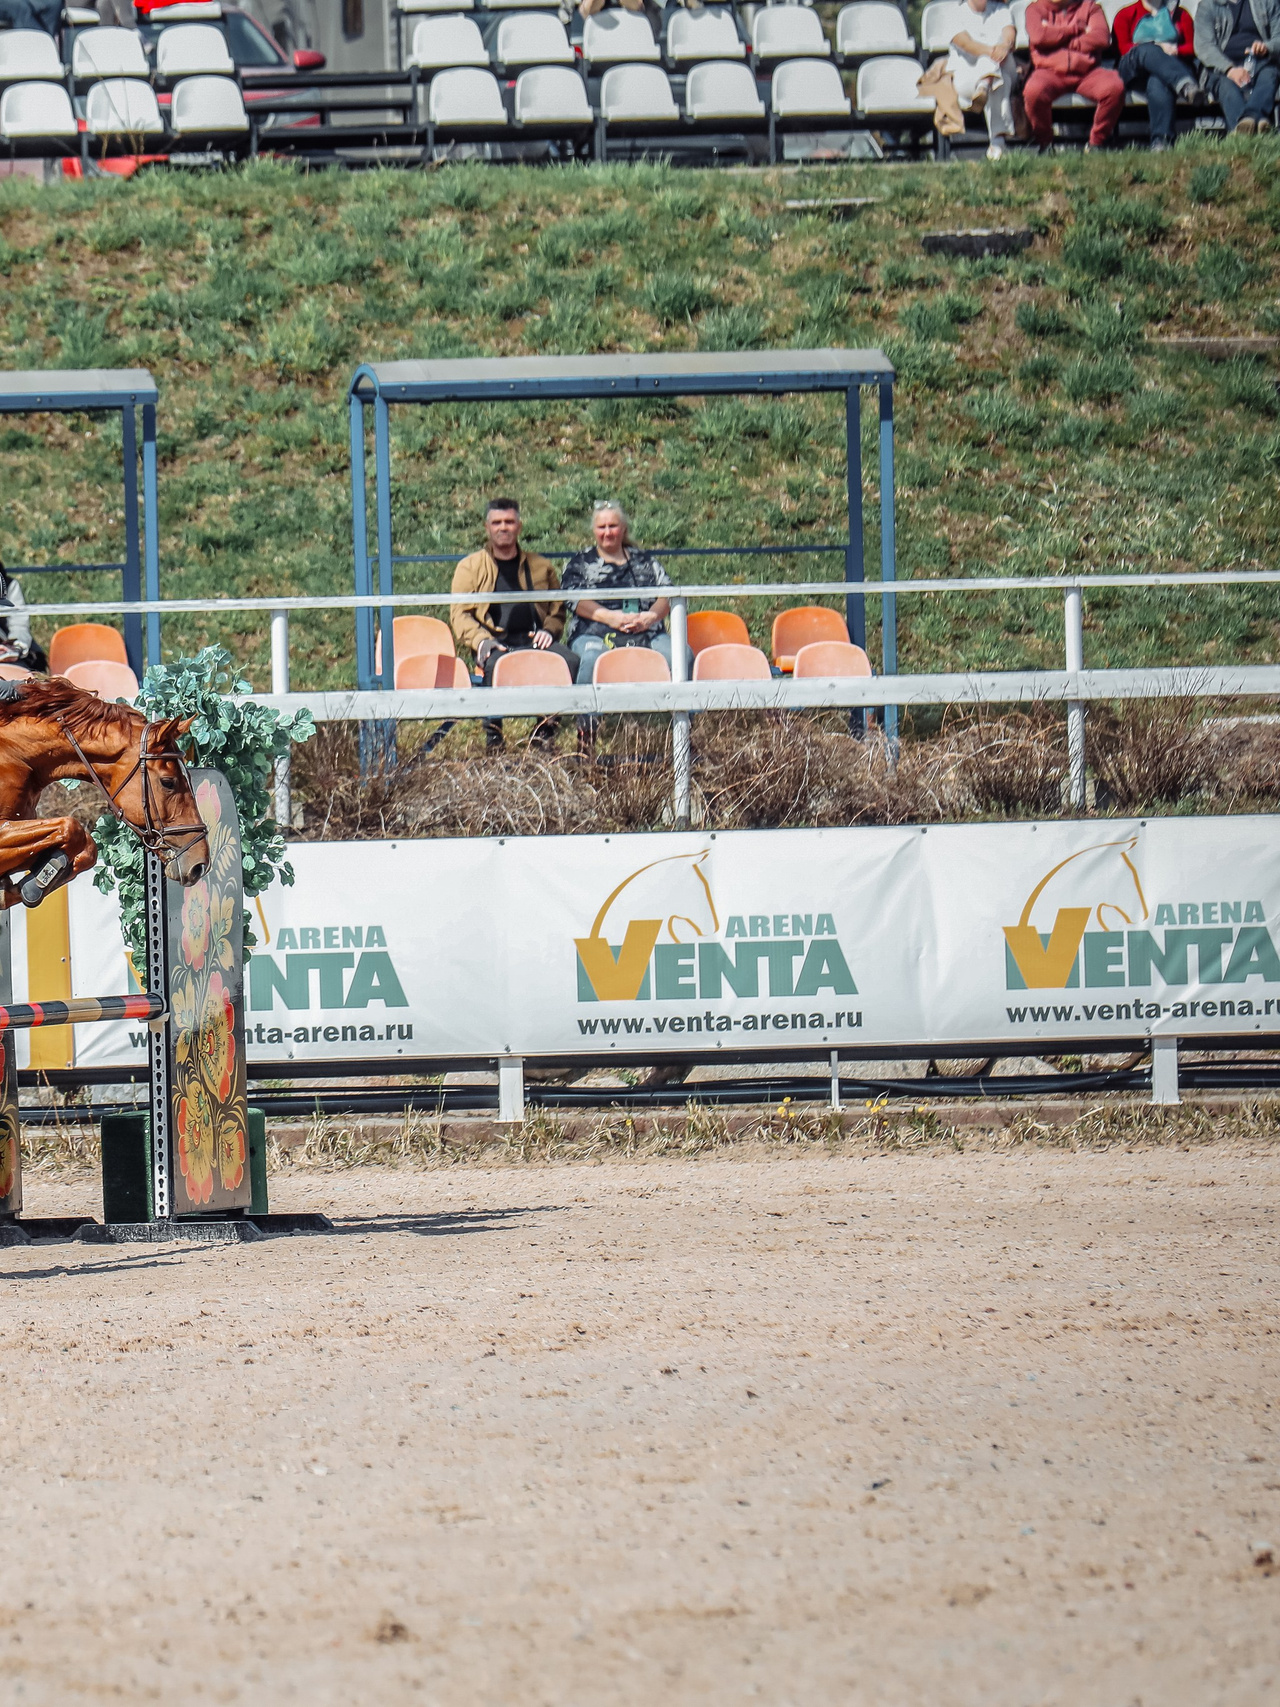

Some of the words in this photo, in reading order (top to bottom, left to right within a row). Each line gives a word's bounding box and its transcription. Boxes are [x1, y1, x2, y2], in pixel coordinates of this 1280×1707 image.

[725, 913, 837, 938] ARENA
[1154, 900, 1266, 926] ARENA
[276, 925, 387, 950] ARENA
[1002, 907, 1280, 990] VENTA
[573, 919, 859, 1002] VENTA
[577, 1011, 863, 1035] www.venta-arena.ru
[1006, 998, 1280, 1023] www.venta-arena.r
